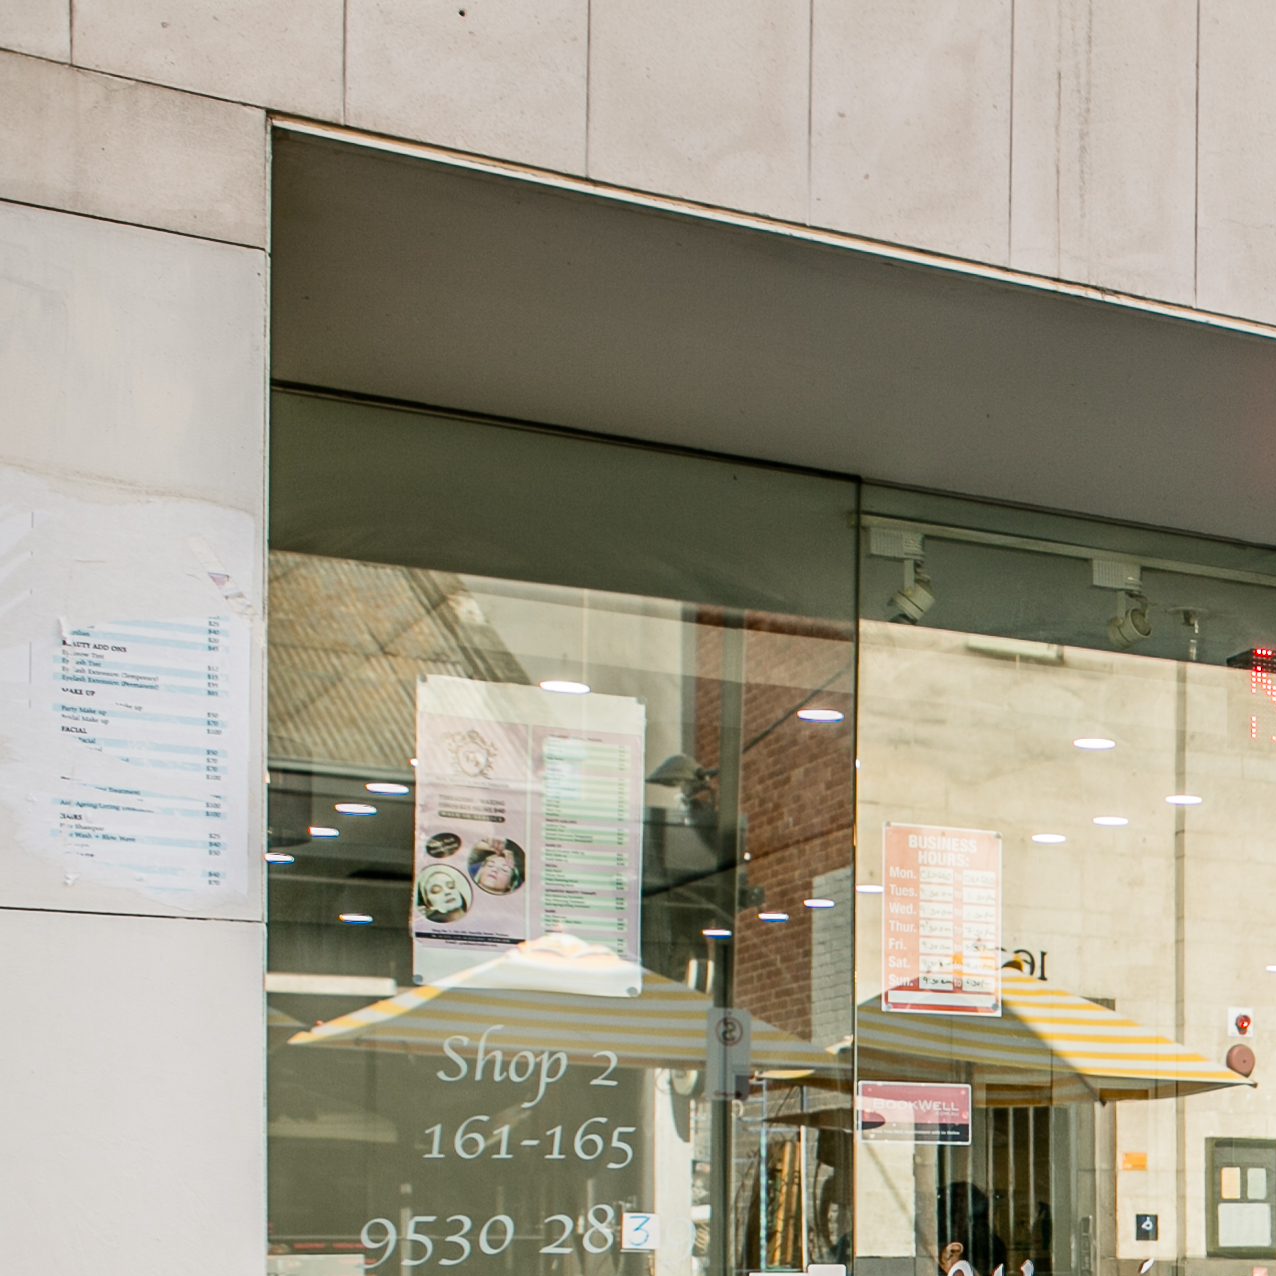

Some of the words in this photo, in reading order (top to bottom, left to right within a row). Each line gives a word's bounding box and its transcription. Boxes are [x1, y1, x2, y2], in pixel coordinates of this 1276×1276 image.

[908, 834, 977, 853] BUSINESS
[918, 851, 970, 867] HOURS:
[889, 866, 917, 880] Mon.
[889, 884, 918, 898] Tues.
[889, 902, 917, 915] Wed.
[889, 920, 917, 933] Thur.
[888, 938, 907, 950] Fri.
[888, 955, 910, 968] Sat.
[888, 973, 914, 987] Sun.
[437, 1025, 569, 1109] Shop
[592, 1050, 619, 1087] 2
[422, 1115, 637, 1170] 161-165
[360, 1214, 515, 1269] 9530
